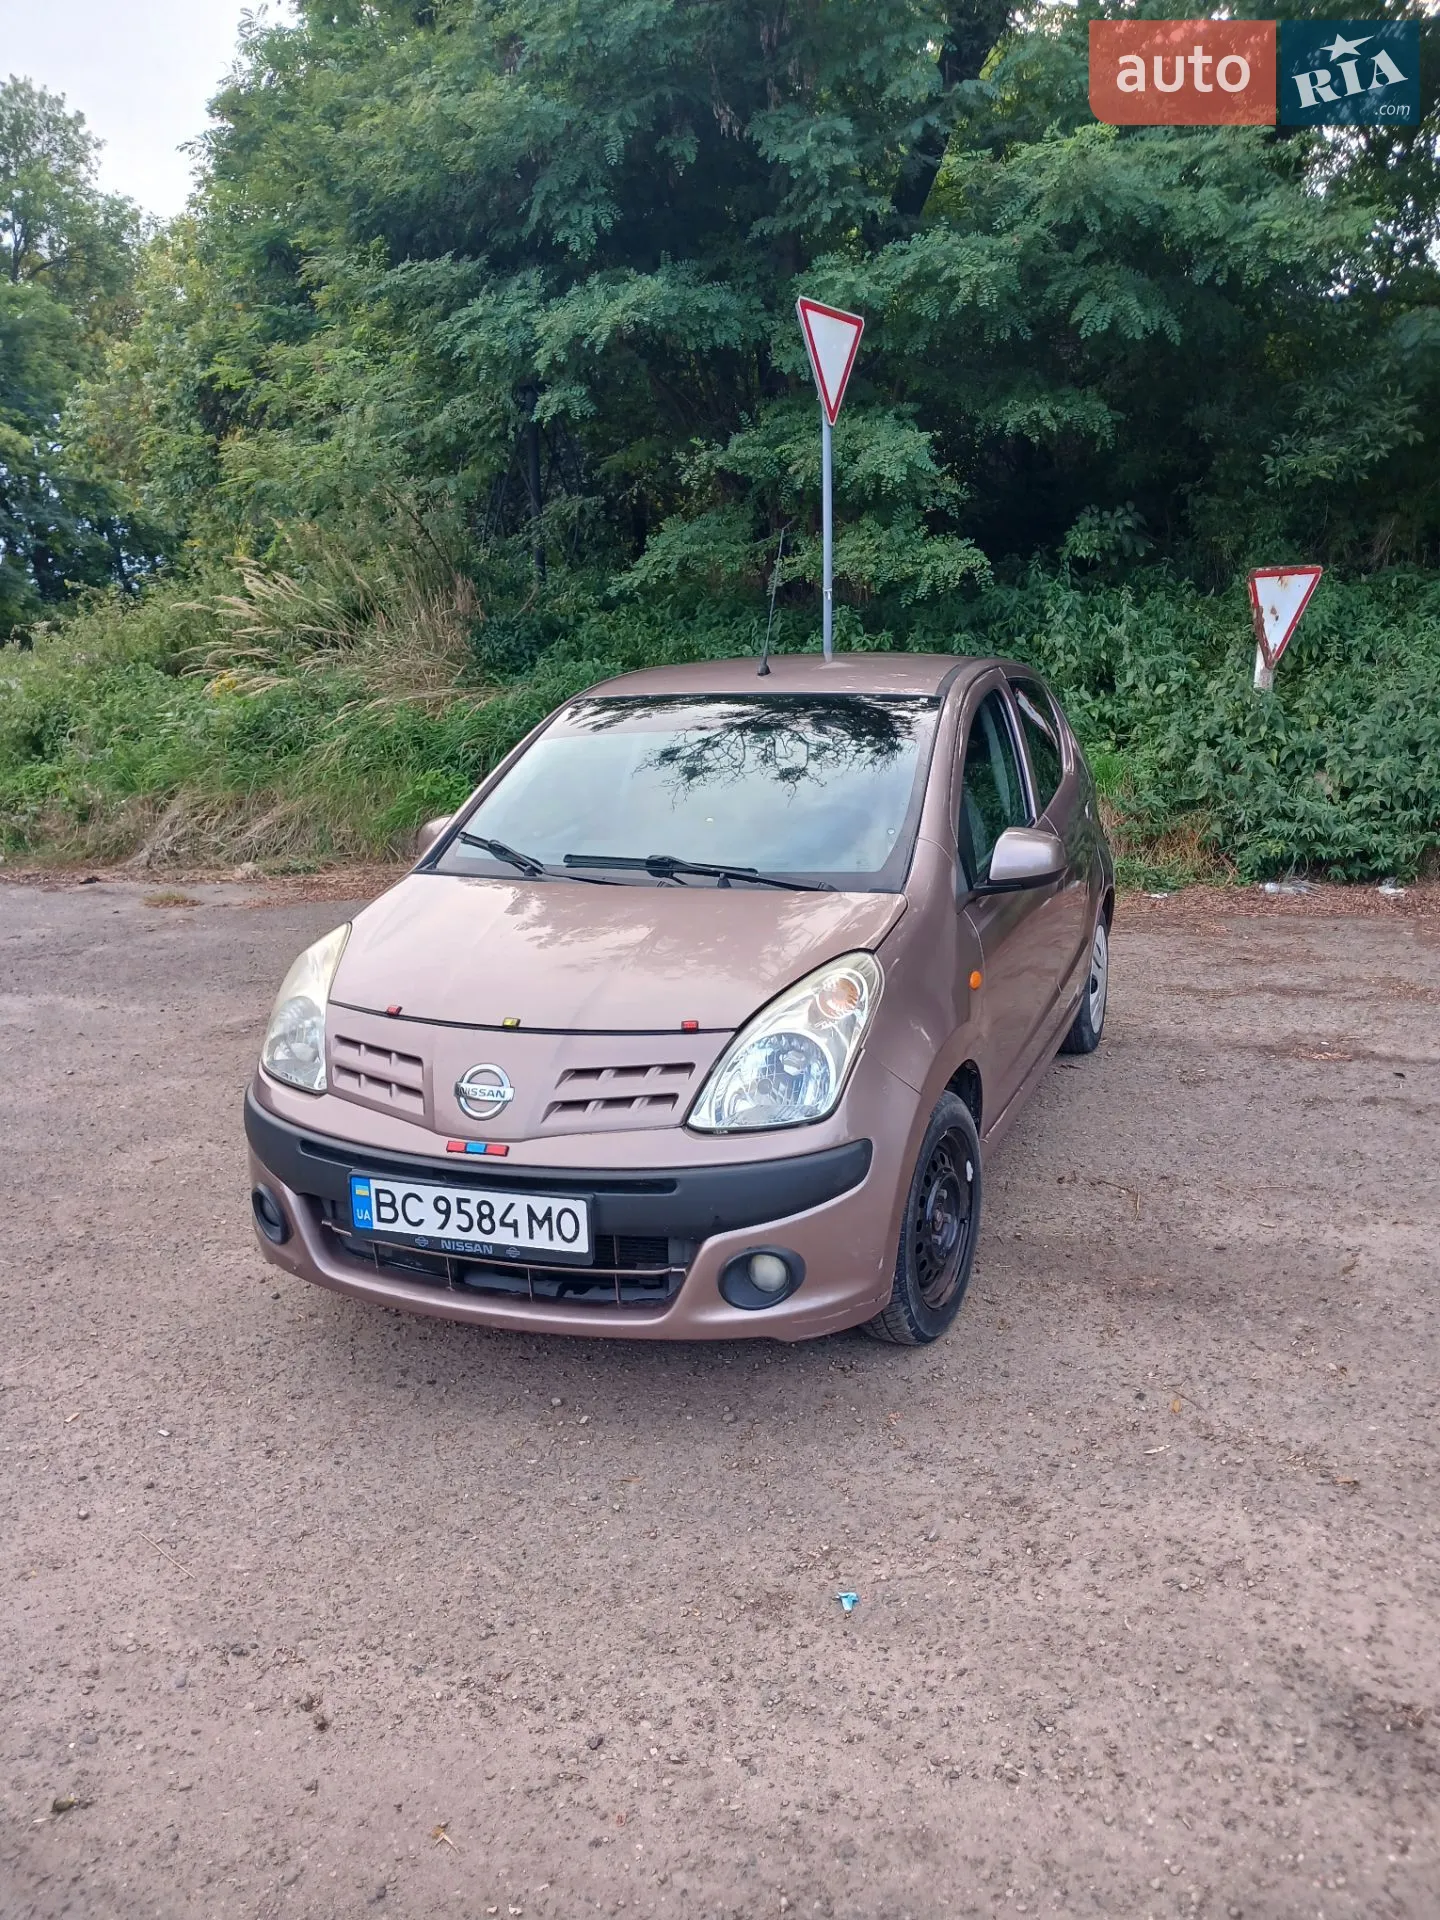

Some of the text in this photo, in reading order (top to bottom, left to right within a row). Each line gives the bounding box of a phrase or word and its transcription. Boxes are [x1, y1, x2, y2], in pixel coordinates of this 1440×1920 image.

[459, 1086, 506, 1098] NISSAN
[356, 1208, 371, 1221] UA
[440, 1240, 493, 1255] NISSAN
